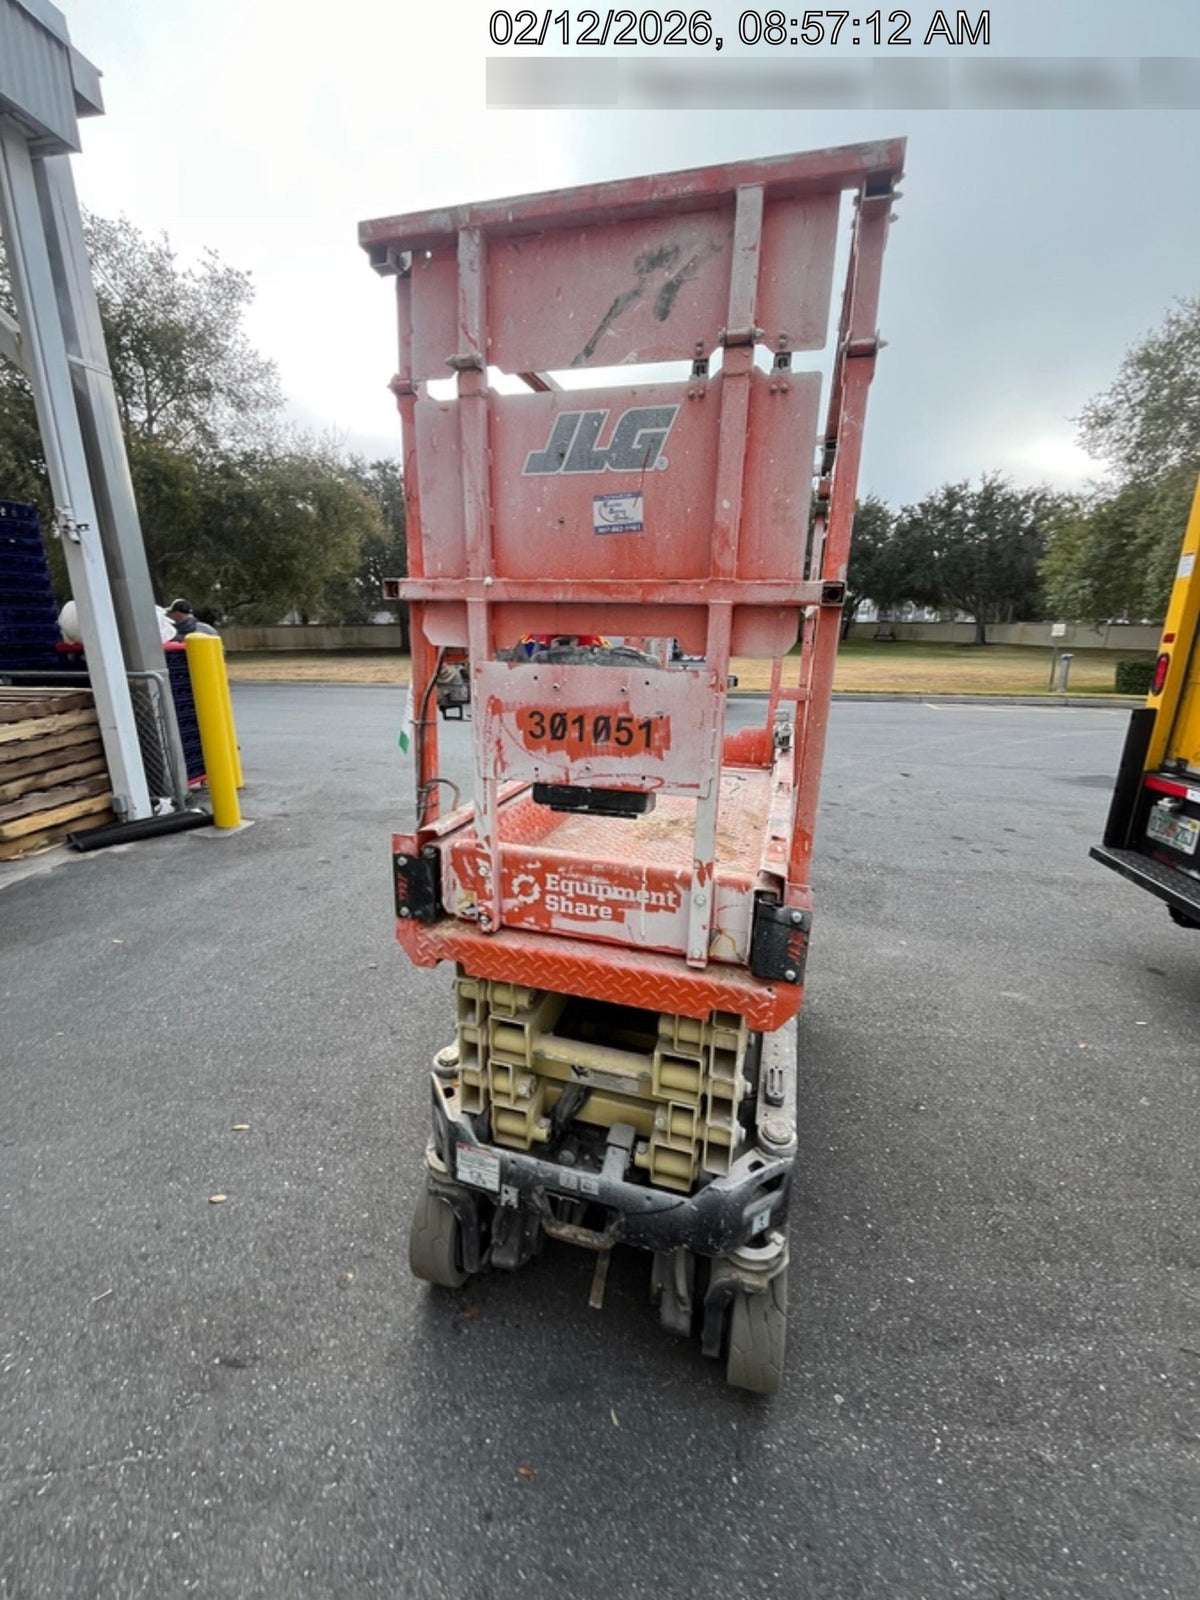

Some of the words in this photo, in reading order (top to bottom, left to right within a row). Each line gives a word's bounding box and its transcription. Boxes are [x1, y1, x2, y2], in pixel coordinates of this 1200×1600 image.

[521, 403, 681, 475] JLG
[528, 710, 653, 748] 301051
[545, 873, 677, 907] Equipment
[545, 894, 613, 919] Share
